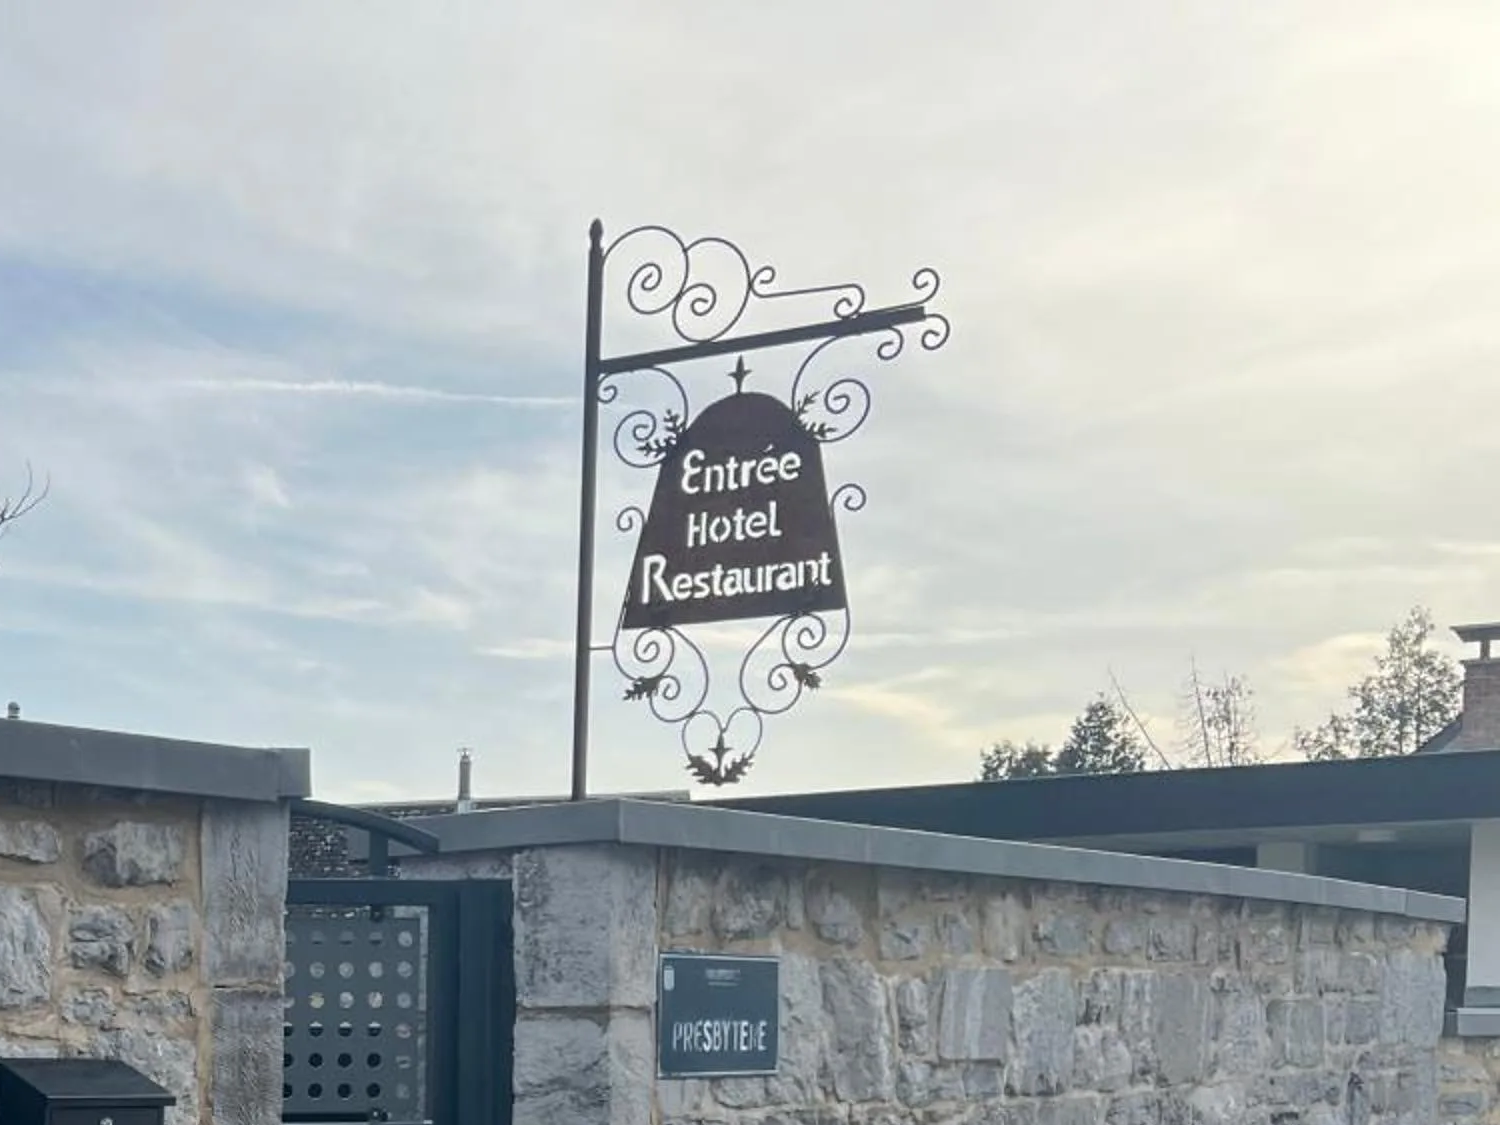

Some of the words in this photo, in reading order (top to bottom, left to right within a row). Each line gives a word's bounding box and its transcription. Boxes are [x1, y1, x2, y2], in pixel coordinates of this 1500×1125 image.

[681, 444, 801, 494] Entrée
[687, 501, 782, 548] Hotel
[641, 552, 832, 604] Restaurant
